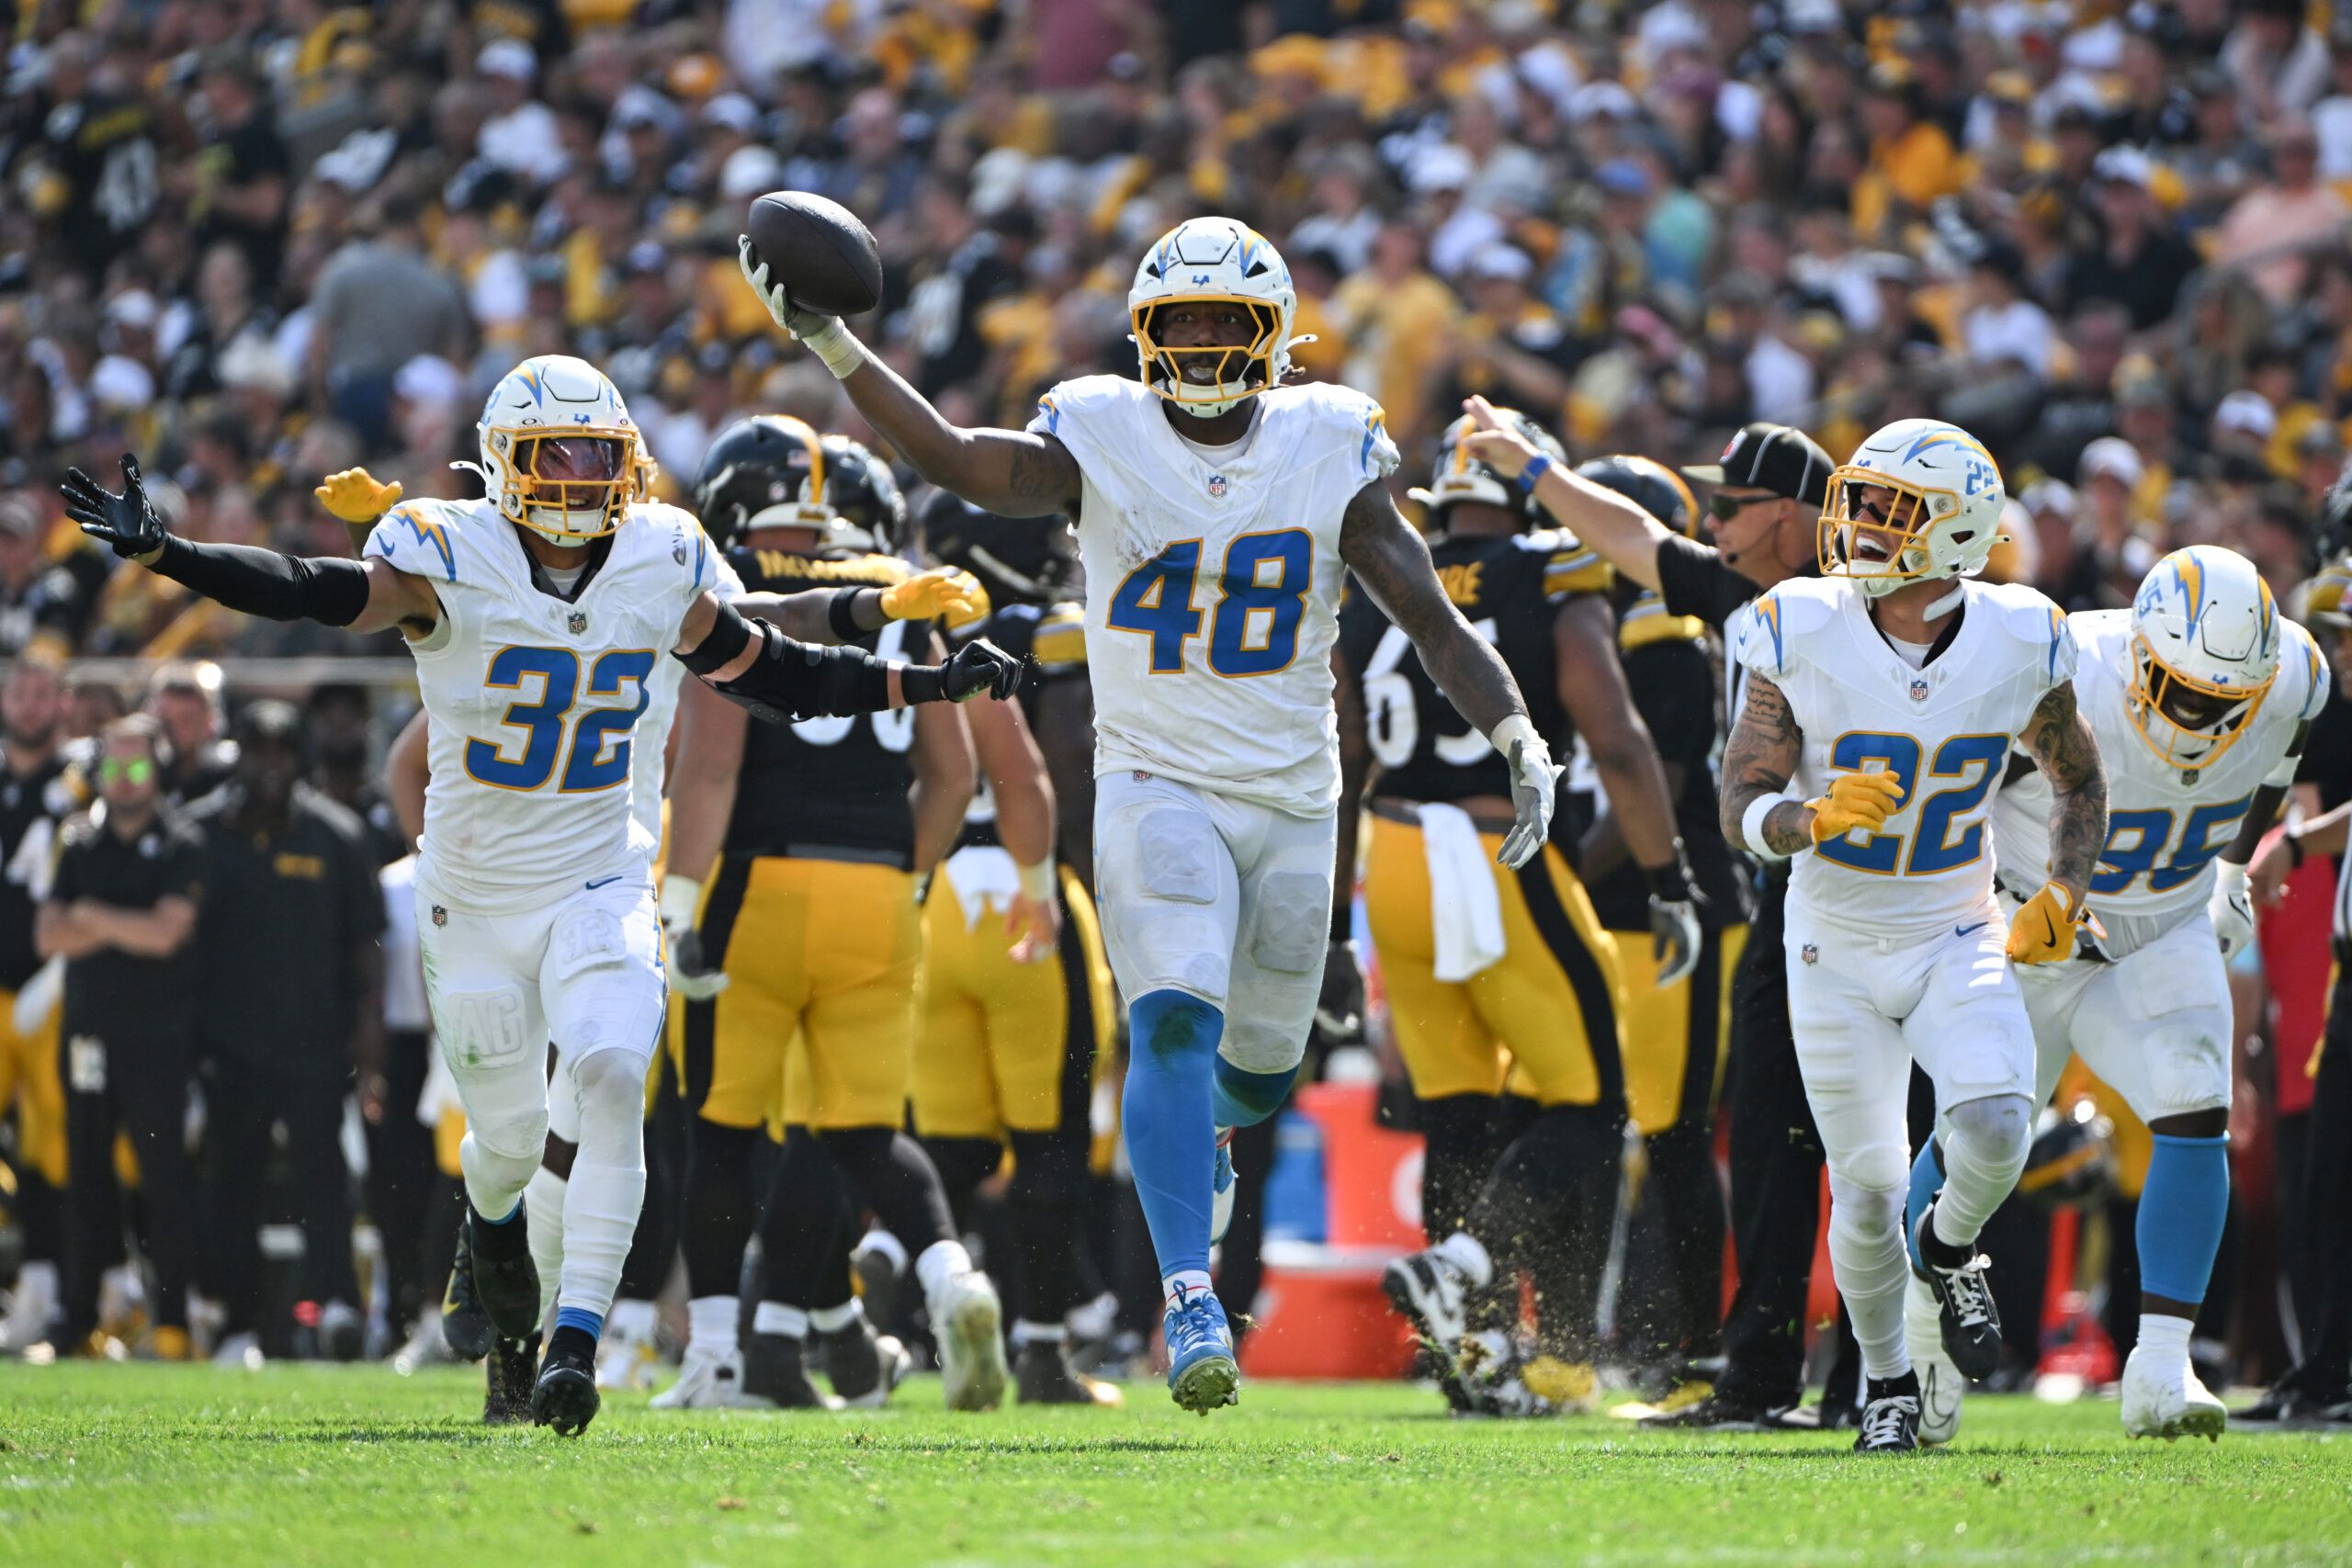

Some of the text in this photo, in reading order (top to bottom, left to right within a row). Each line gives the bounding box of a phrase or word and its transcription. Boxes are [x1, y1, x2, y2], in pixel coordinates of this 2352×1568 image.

[1106, 526, 1314, 678] 48
[463, 645, 657, 793] 32
[1814, 730, 2011, 876] 22
[2048, 787, 2256, 896] 95
[459, 994, 523, 1057] AG
